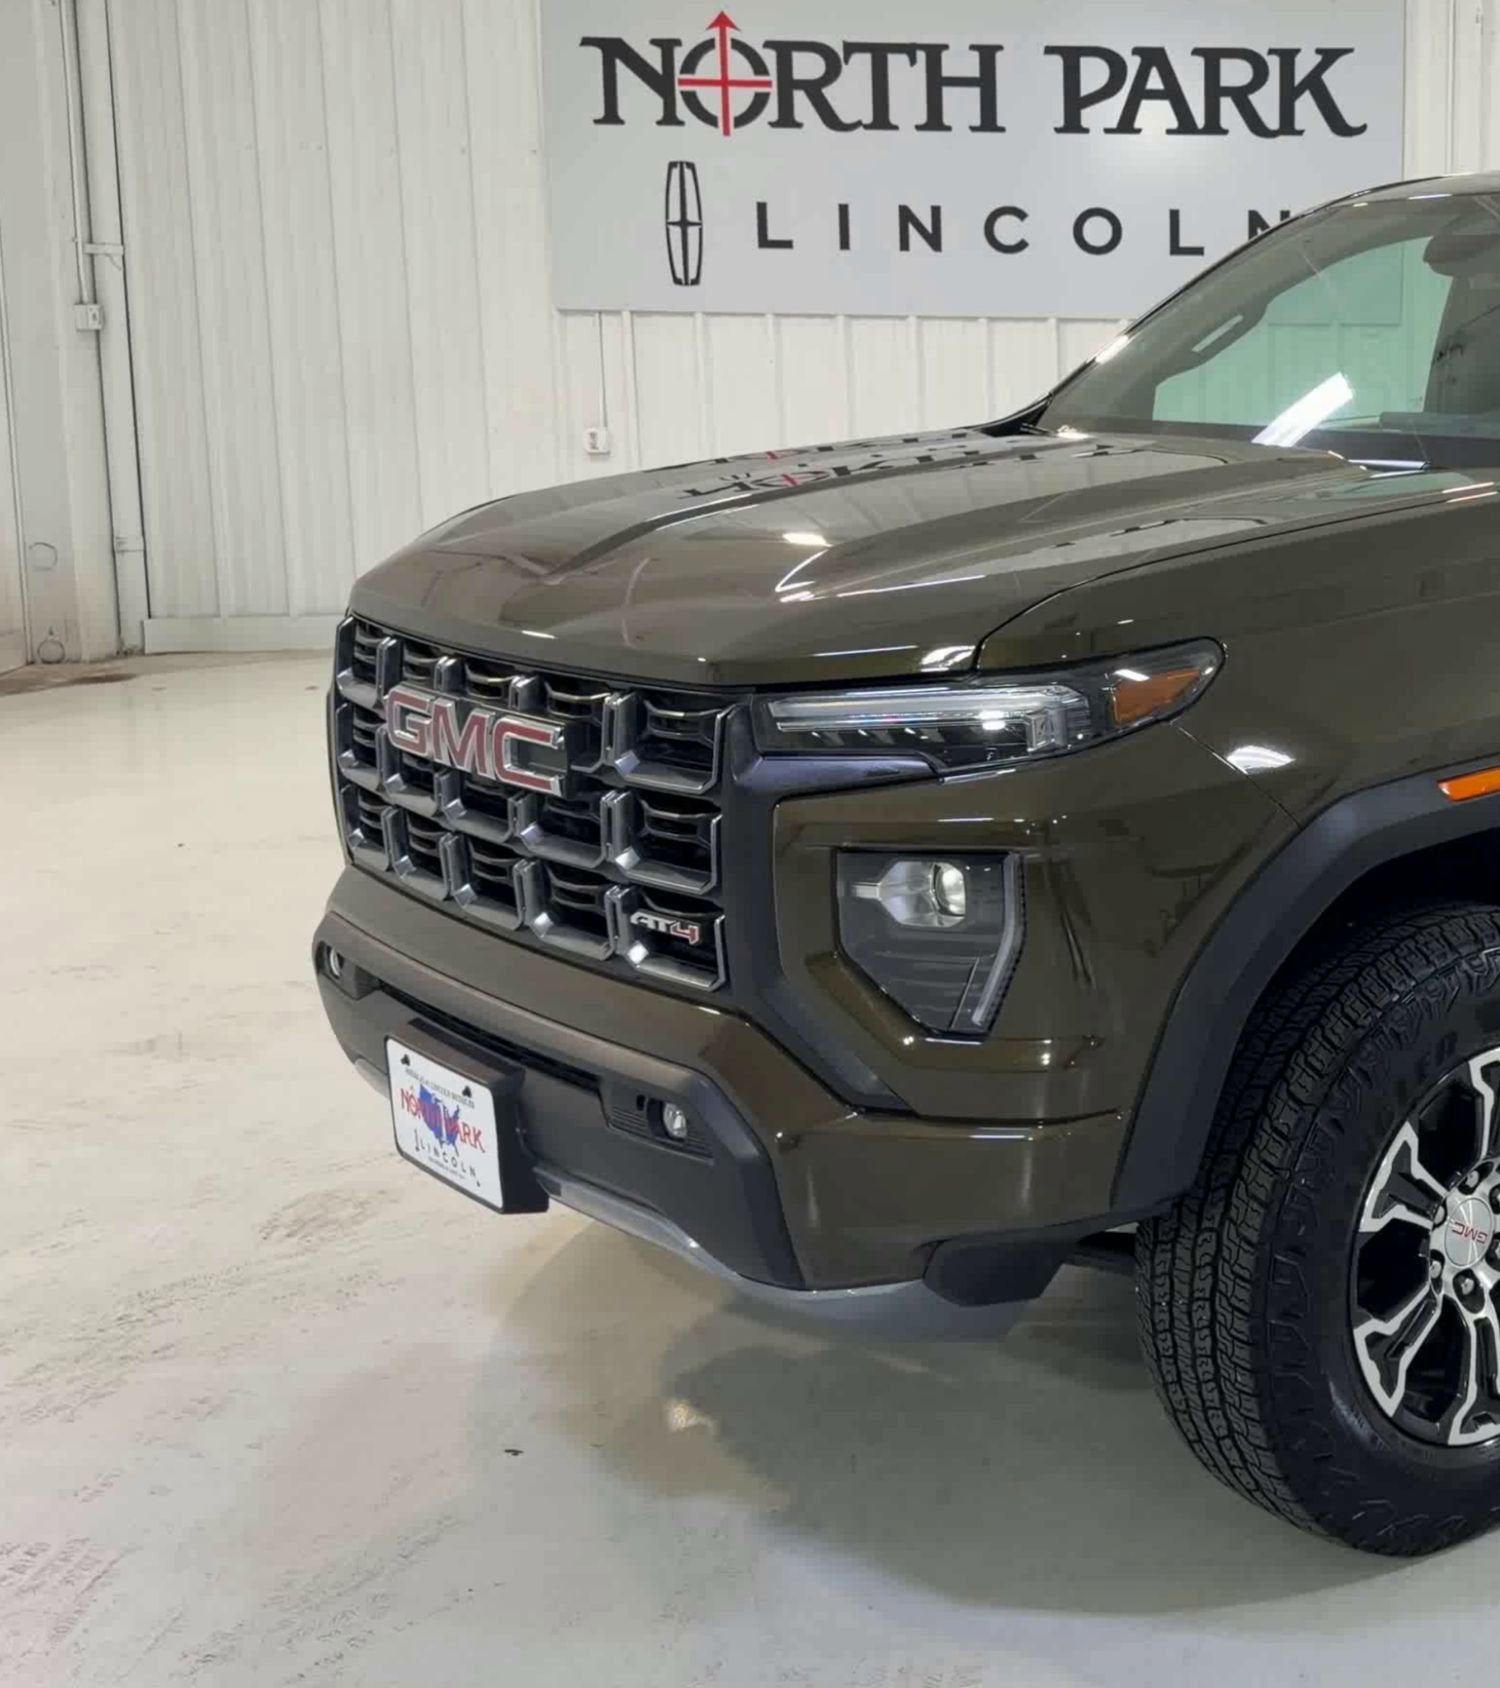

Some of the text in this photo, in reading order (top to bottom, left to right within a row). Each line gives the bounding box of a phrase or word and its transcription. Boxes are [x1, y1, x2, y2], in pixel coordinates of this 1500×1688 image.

[578, 35, 1368, 139] NORTH PARK
[384, 684, 567, 798] GMC
[630, 910, 701, 946] AT4
[1451, 1221, 1489, 1245] GMC
